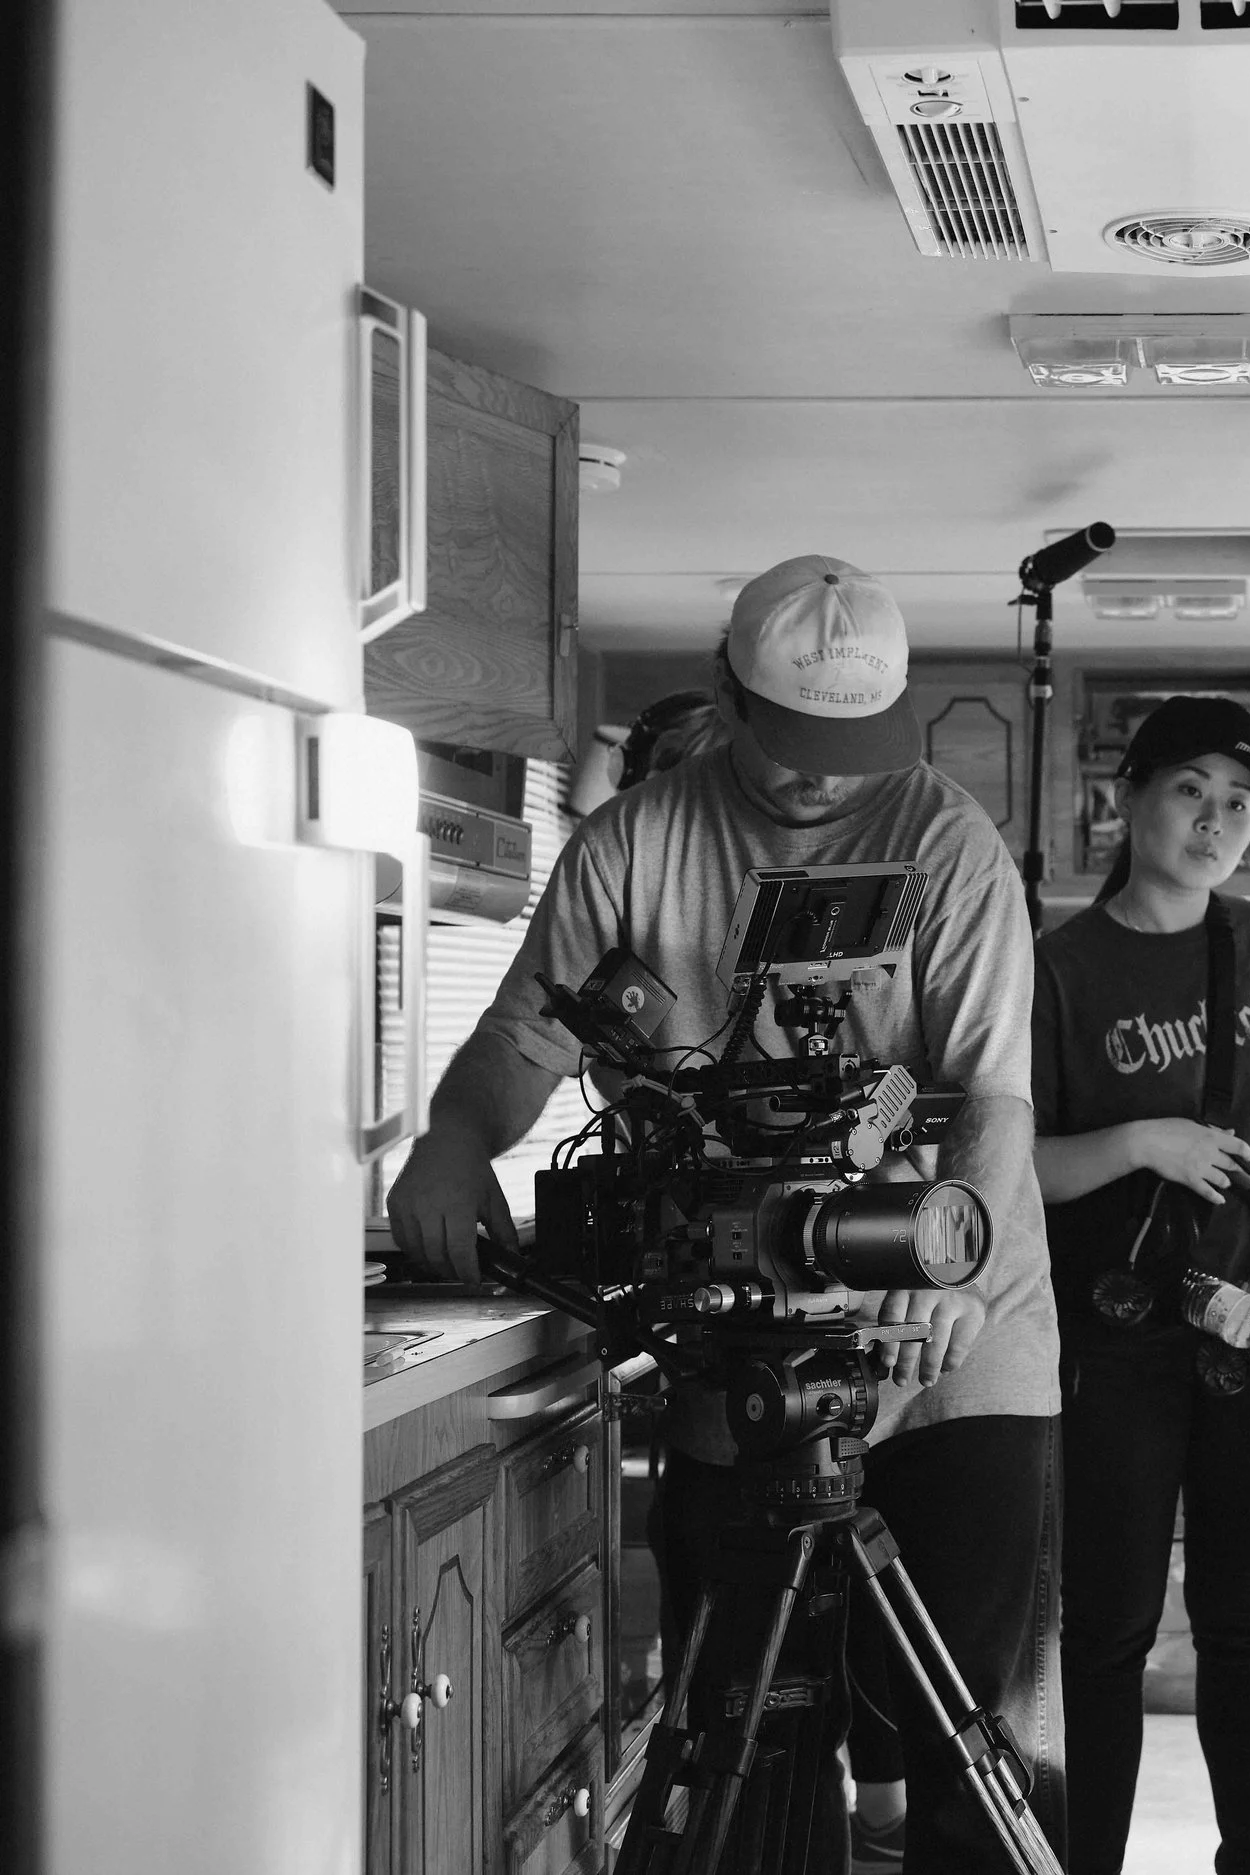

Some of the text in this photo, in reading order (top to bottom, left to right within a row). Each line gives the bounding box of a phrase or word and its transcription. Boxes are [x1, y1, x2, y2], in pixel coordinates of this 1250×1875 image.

[791, 649, 825, 671] WEST
[925, 1116, 949, 1124] SONY
[892, 1229, 907, 1243] 72
[805, 1378, 842, 1390] sachtler
